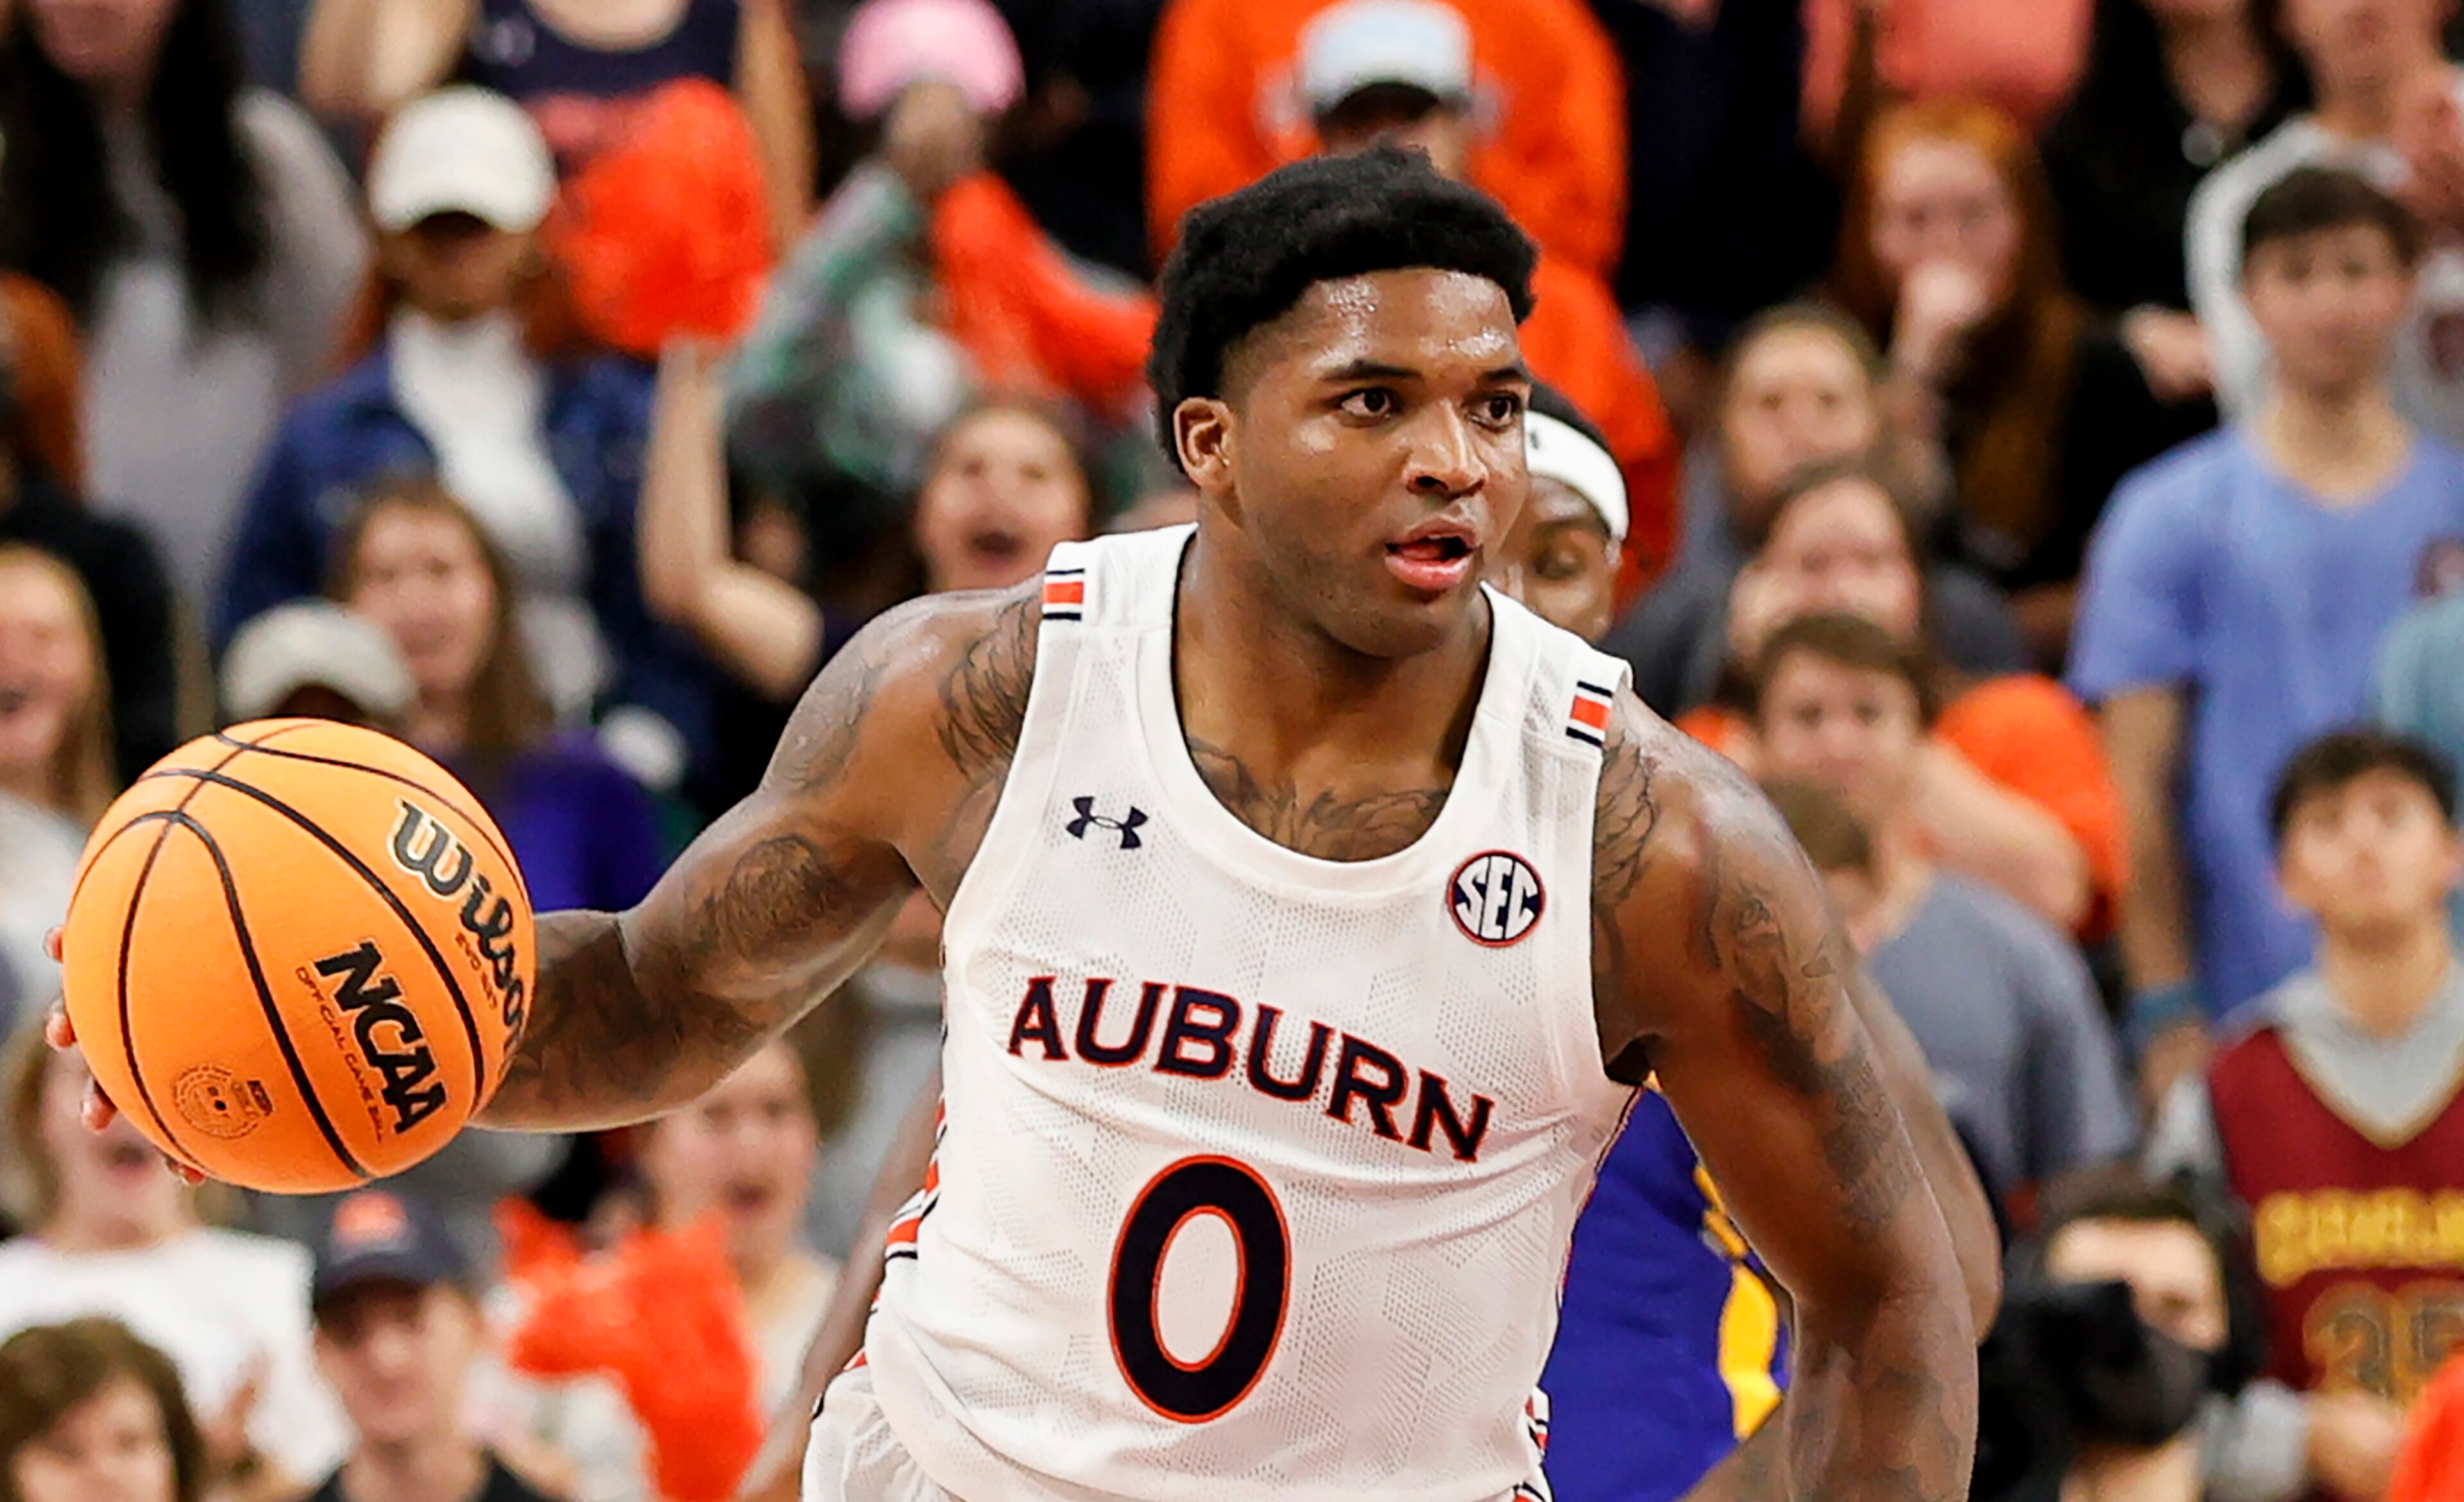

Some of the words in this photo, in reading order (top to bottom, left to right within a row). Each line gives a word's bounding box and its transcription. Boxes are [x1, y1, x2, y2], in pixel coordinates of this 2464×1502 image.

[1455, 855, 1539, 941] SEC
[314, 941, 447, 1135] NCAA
[1007, 976, 1495, 1163] AUBURN
[1107, 1154, 1292, 1424] 0
